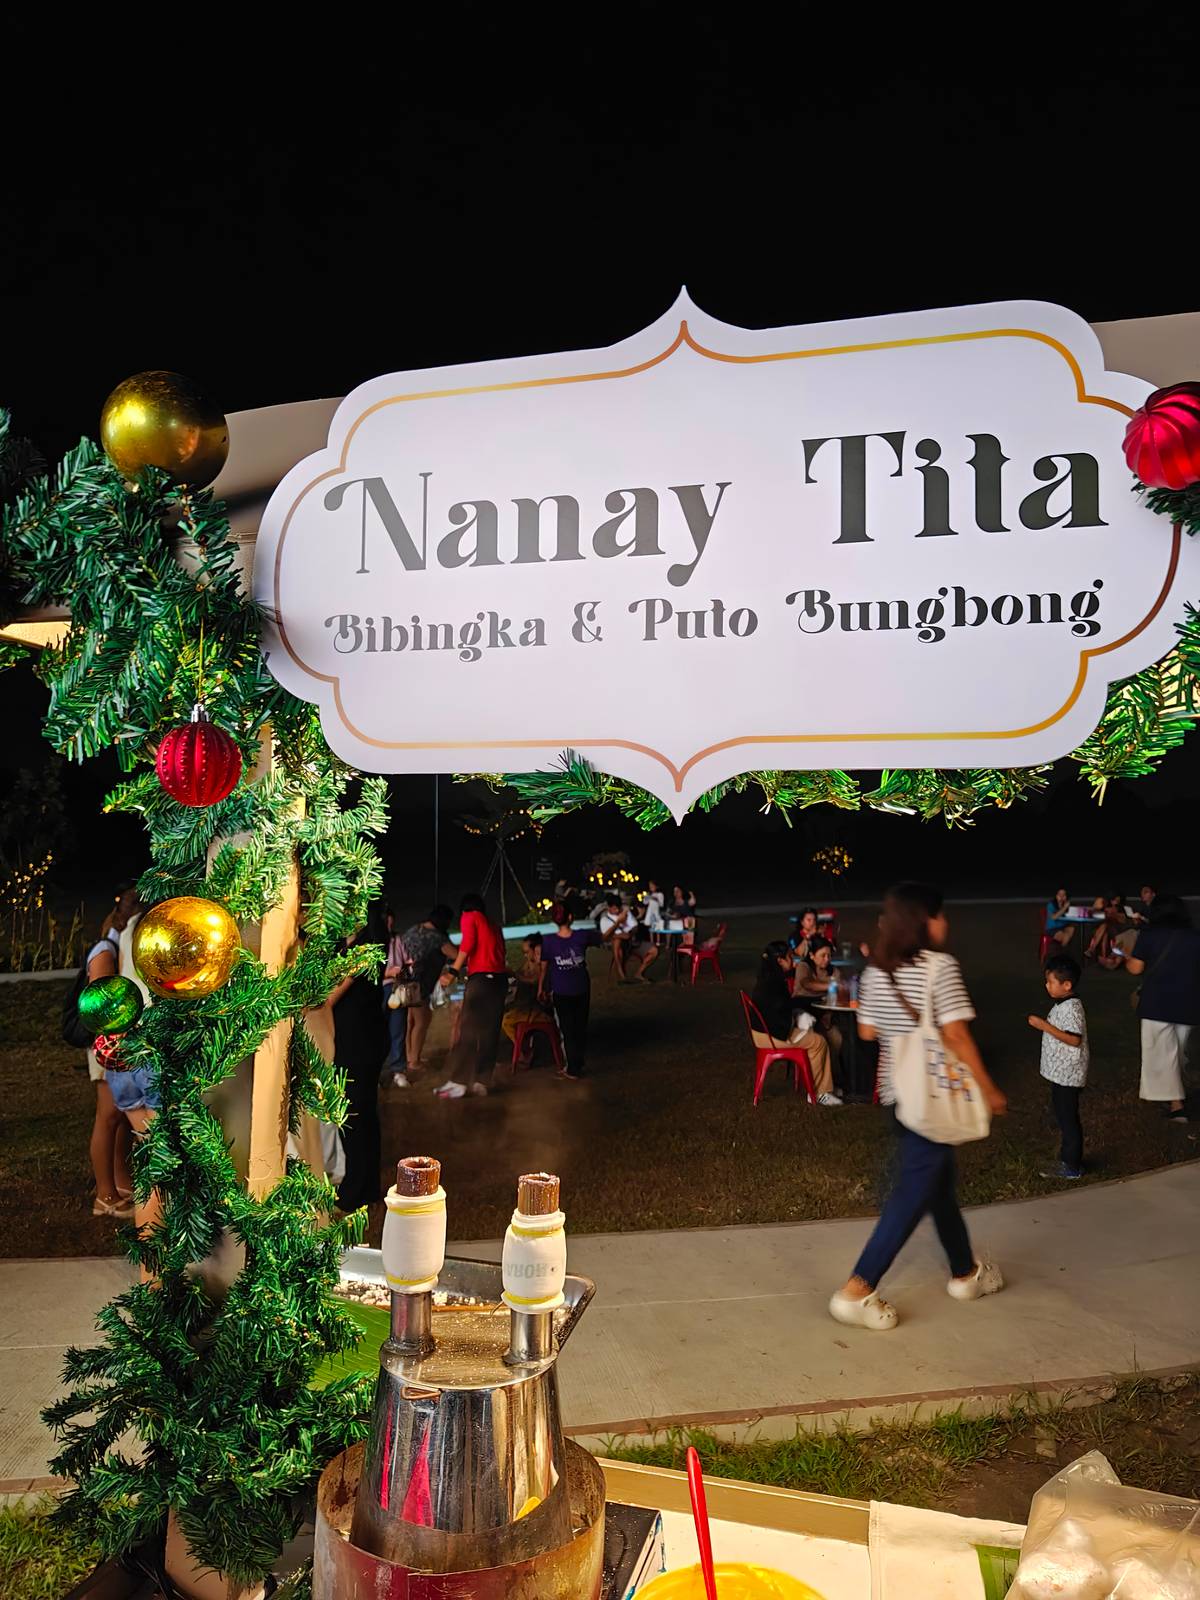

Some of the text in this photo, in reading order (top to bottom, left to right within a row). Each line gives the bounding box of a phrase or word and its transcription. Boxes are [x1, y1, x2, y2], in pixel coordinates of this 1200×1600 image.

[325, 430, 1109, 587] Nanay Tita
[325, 579, 1105, 663] Bibingka & Puto Bungbong
